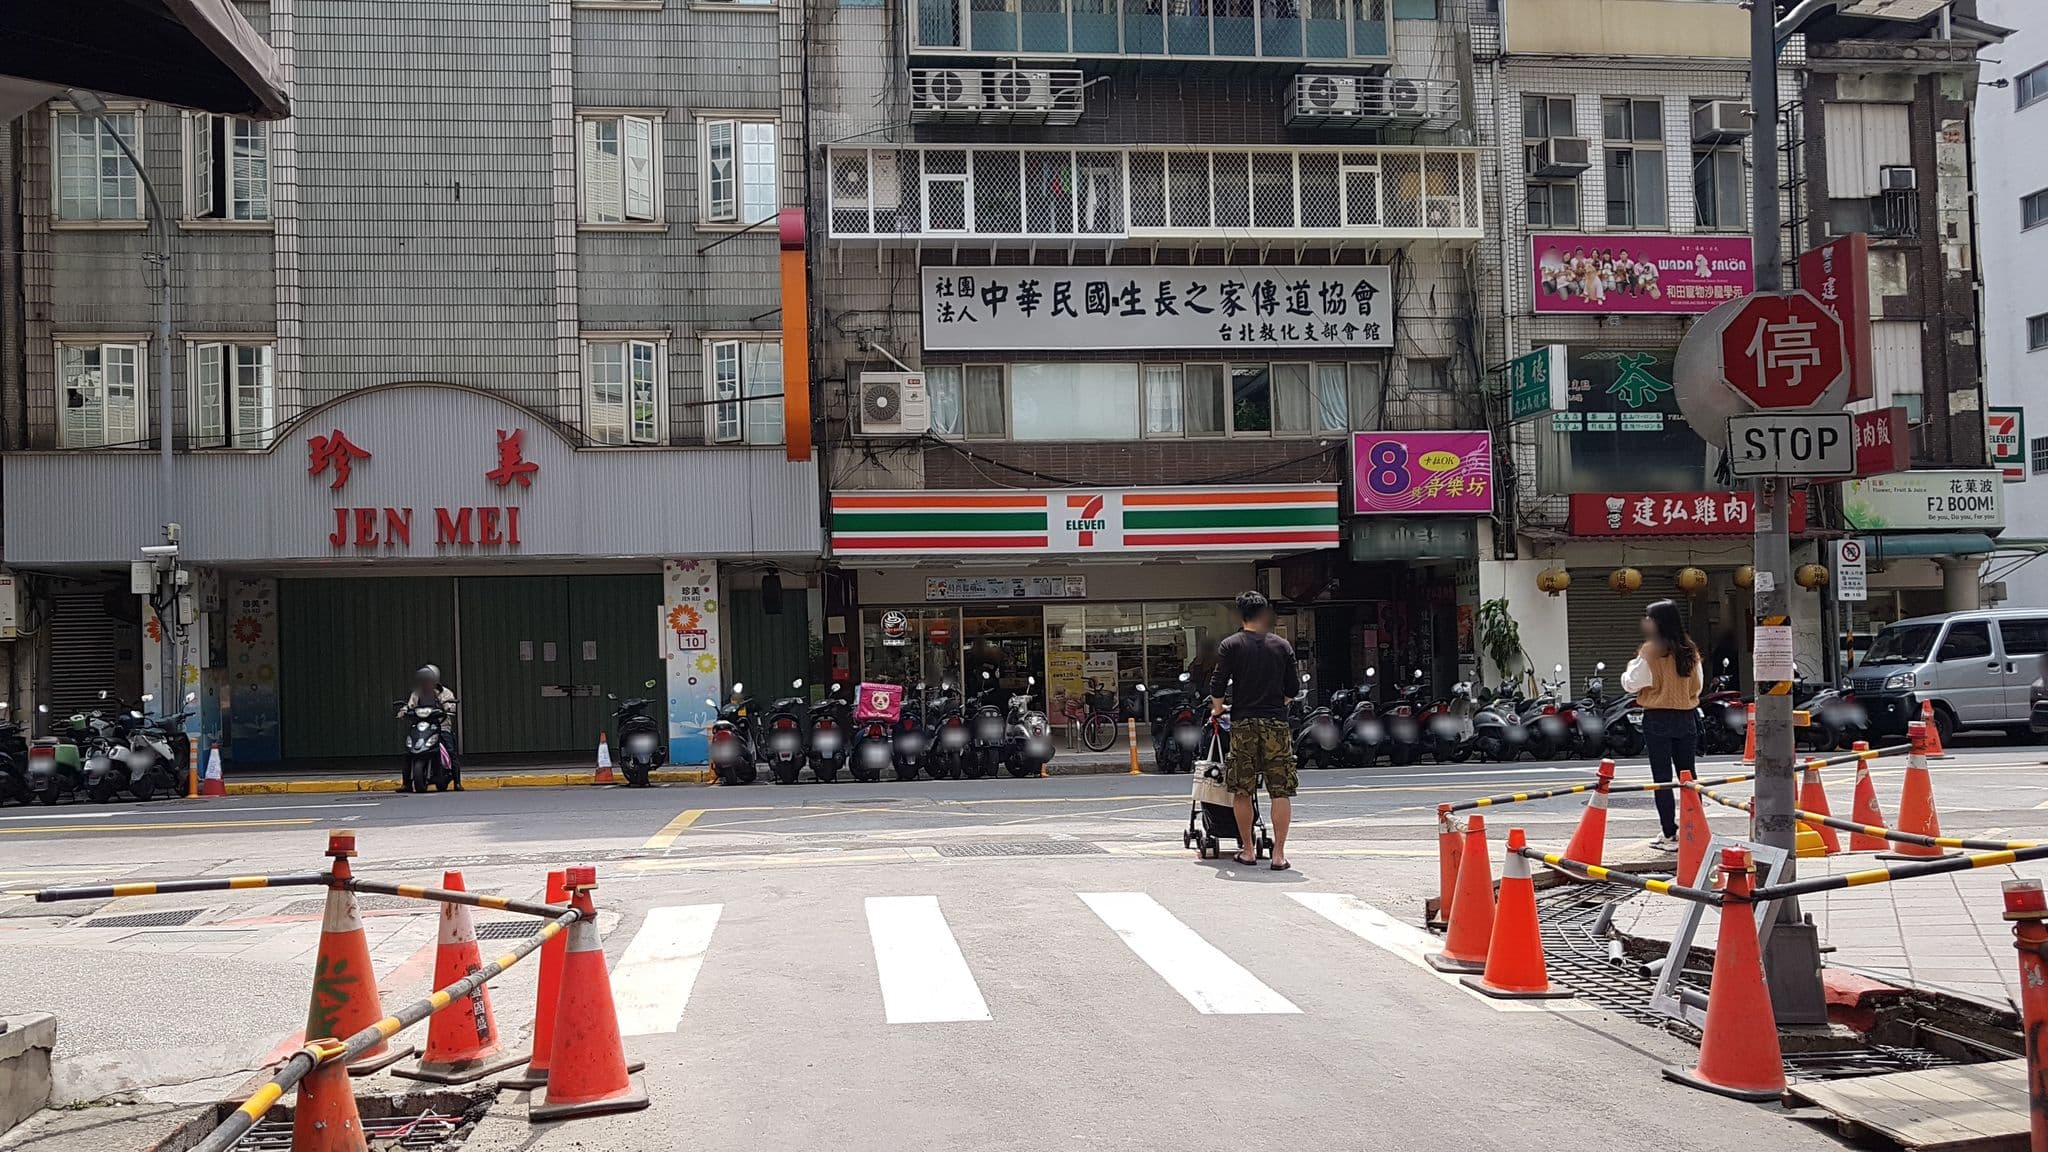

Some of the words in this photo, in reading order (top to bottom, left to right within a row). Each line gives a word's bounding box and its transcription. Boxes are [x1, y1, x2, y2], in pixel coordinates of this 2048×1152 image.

[935, 276, 975, 297] 社團
[936, 304, 978, 324] 法人
[1218, 321, 1382, 342] 台北教化支部會館
[1745, 315, 1822, 388] 停
[1605, 352, 1674, 408] 茶
[1745, 428, 1838, 460] STOP
[1367, 440, 1411, 496] 8
[1949, 479, 1993, 494] 花菓波
[1632, 496, 1757, 526] 建弘雞肉
[1927, 496, 1943, 511] F2
[1948, 496, 1994, 511] BOOM!
[329, 507, 413, 547] JEN
[434, 507, 521, 545] MEI
[1067, 495, 1103, 546] 7
[685, 637, 699, 647] 10
